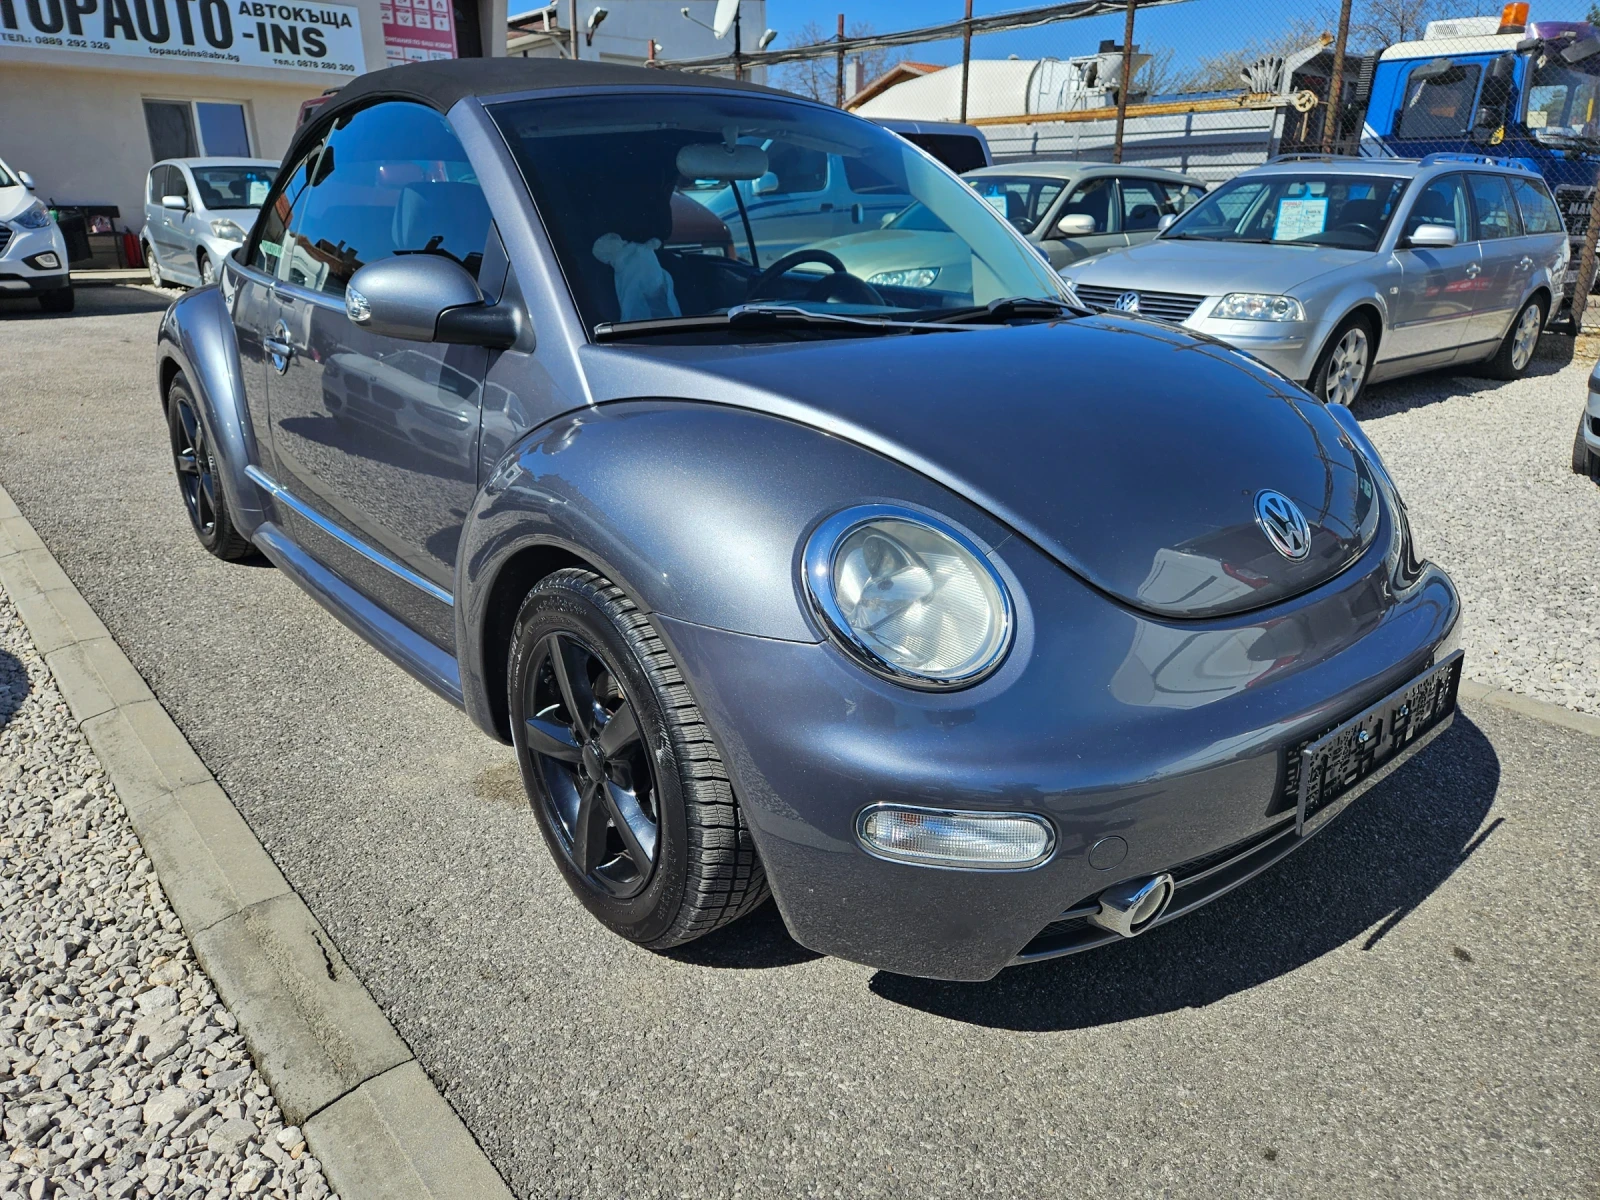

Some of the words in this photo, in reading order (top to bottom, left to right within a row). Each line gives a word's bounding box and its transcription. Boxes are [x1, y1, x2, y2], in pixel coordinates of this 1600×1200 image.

[238, 1, 352, 29] АВТОКЪЩА
[66, 38, 88, 49] 292
[90, 40, 110, 50] 326
[148, 46, 240, 62] topautoins@abv.bg
